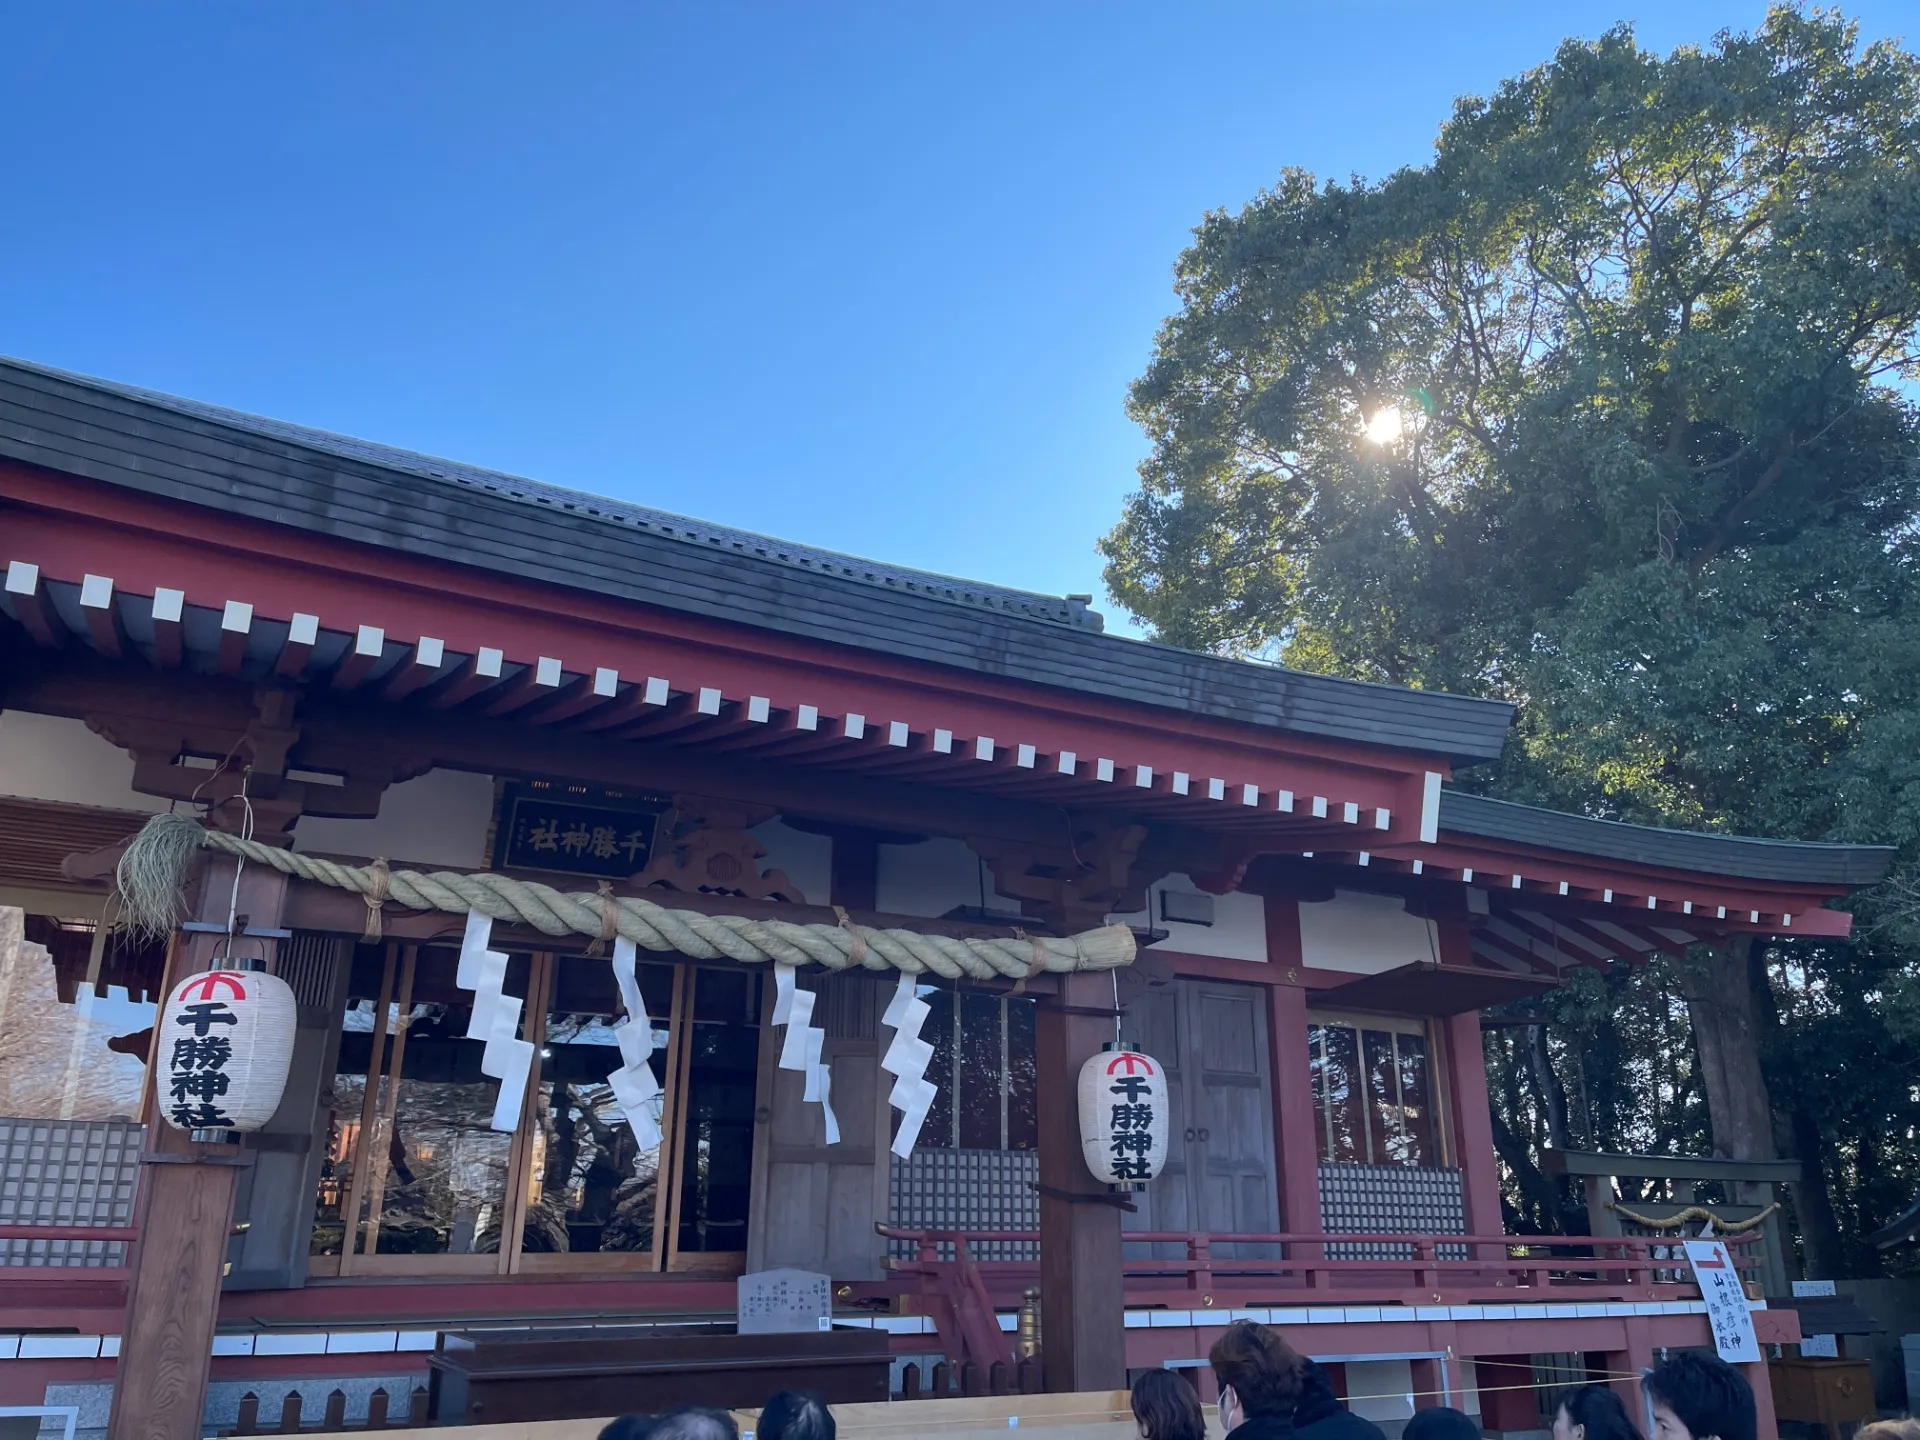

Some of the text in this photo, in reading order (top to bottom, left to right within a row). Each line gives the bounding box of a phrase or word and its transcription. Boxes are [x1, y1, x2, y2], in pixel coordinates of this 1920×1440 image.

[528, 818, 647, 864] 千勝神社
[170, 1002, 238, 1128] 千勝神社
[1109, 1076, 1154, 1180] 千勝神社
